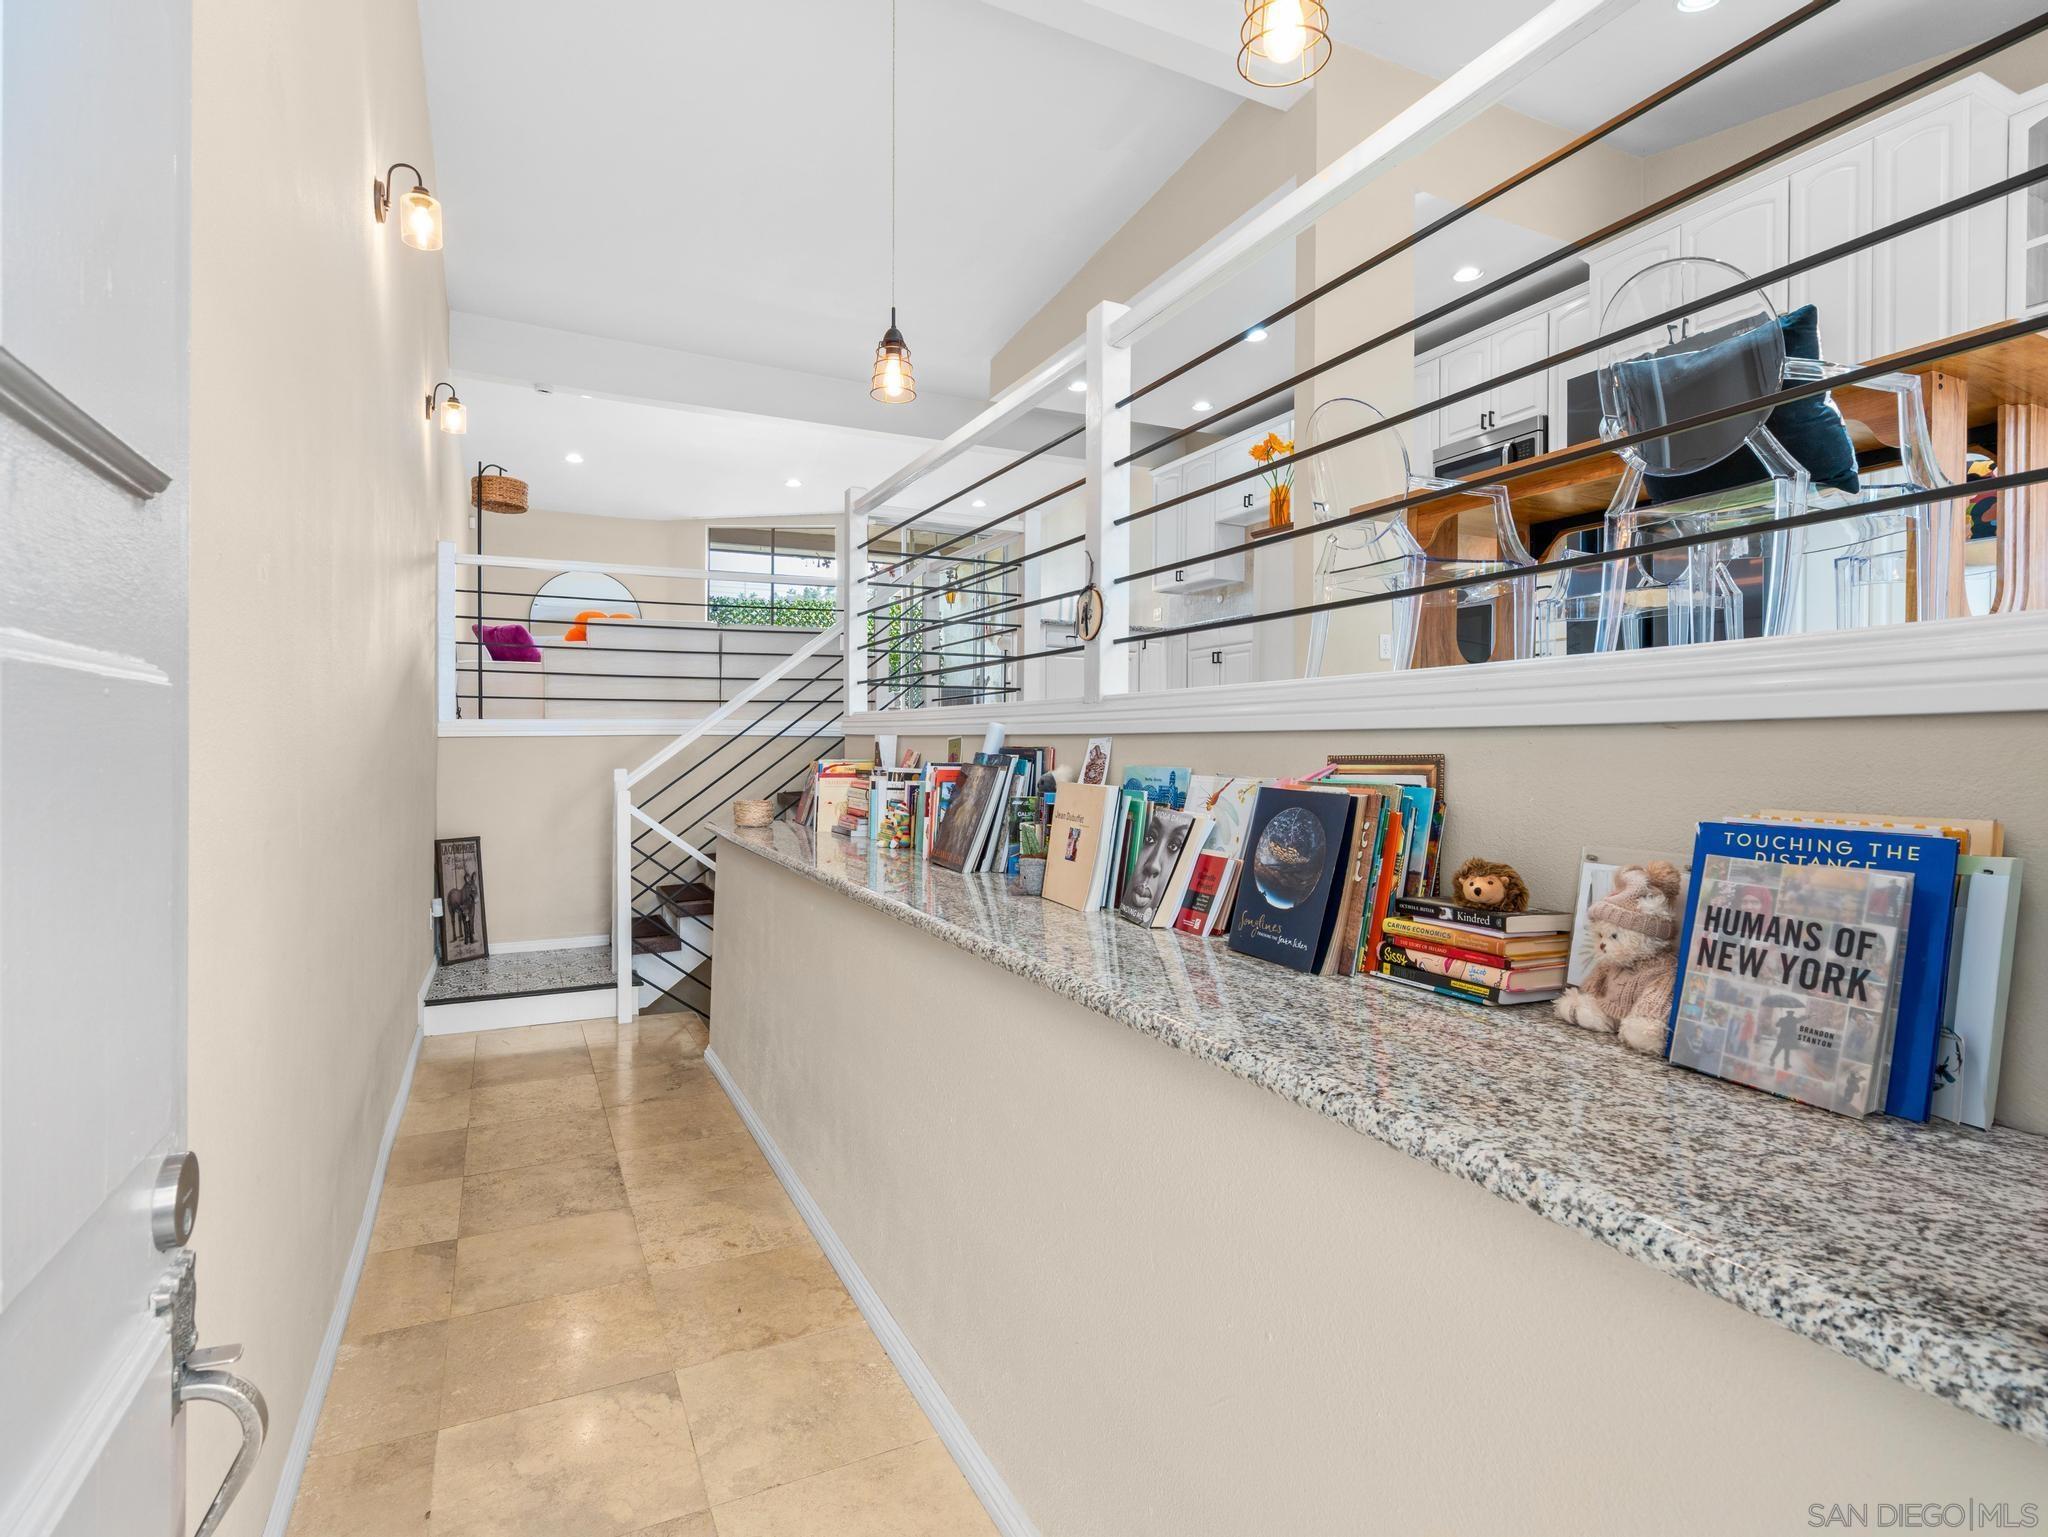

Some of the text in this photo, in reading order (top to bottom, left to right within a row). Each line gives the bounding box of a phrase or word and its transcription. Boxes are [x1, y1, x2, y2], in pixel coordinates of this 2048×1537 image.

[1724, 832, 1921, 862] TOUCHING THE
[1457, 911, 1490, 926] Kindred
[1387, 921, 1452, 939] CARING ECONOMICS
[1703, 905, 1878, 961] HUMANS OF
[1428, 945, 1447, 954] IRELAND
[1468, 965, 1487, 976] Jacob
[1697, 937, 1872, 1002] NEW YORK
[1799, 1025, 1835, 1040] BRANDON
[1797, 1034, 1833, 1049] STANTON
